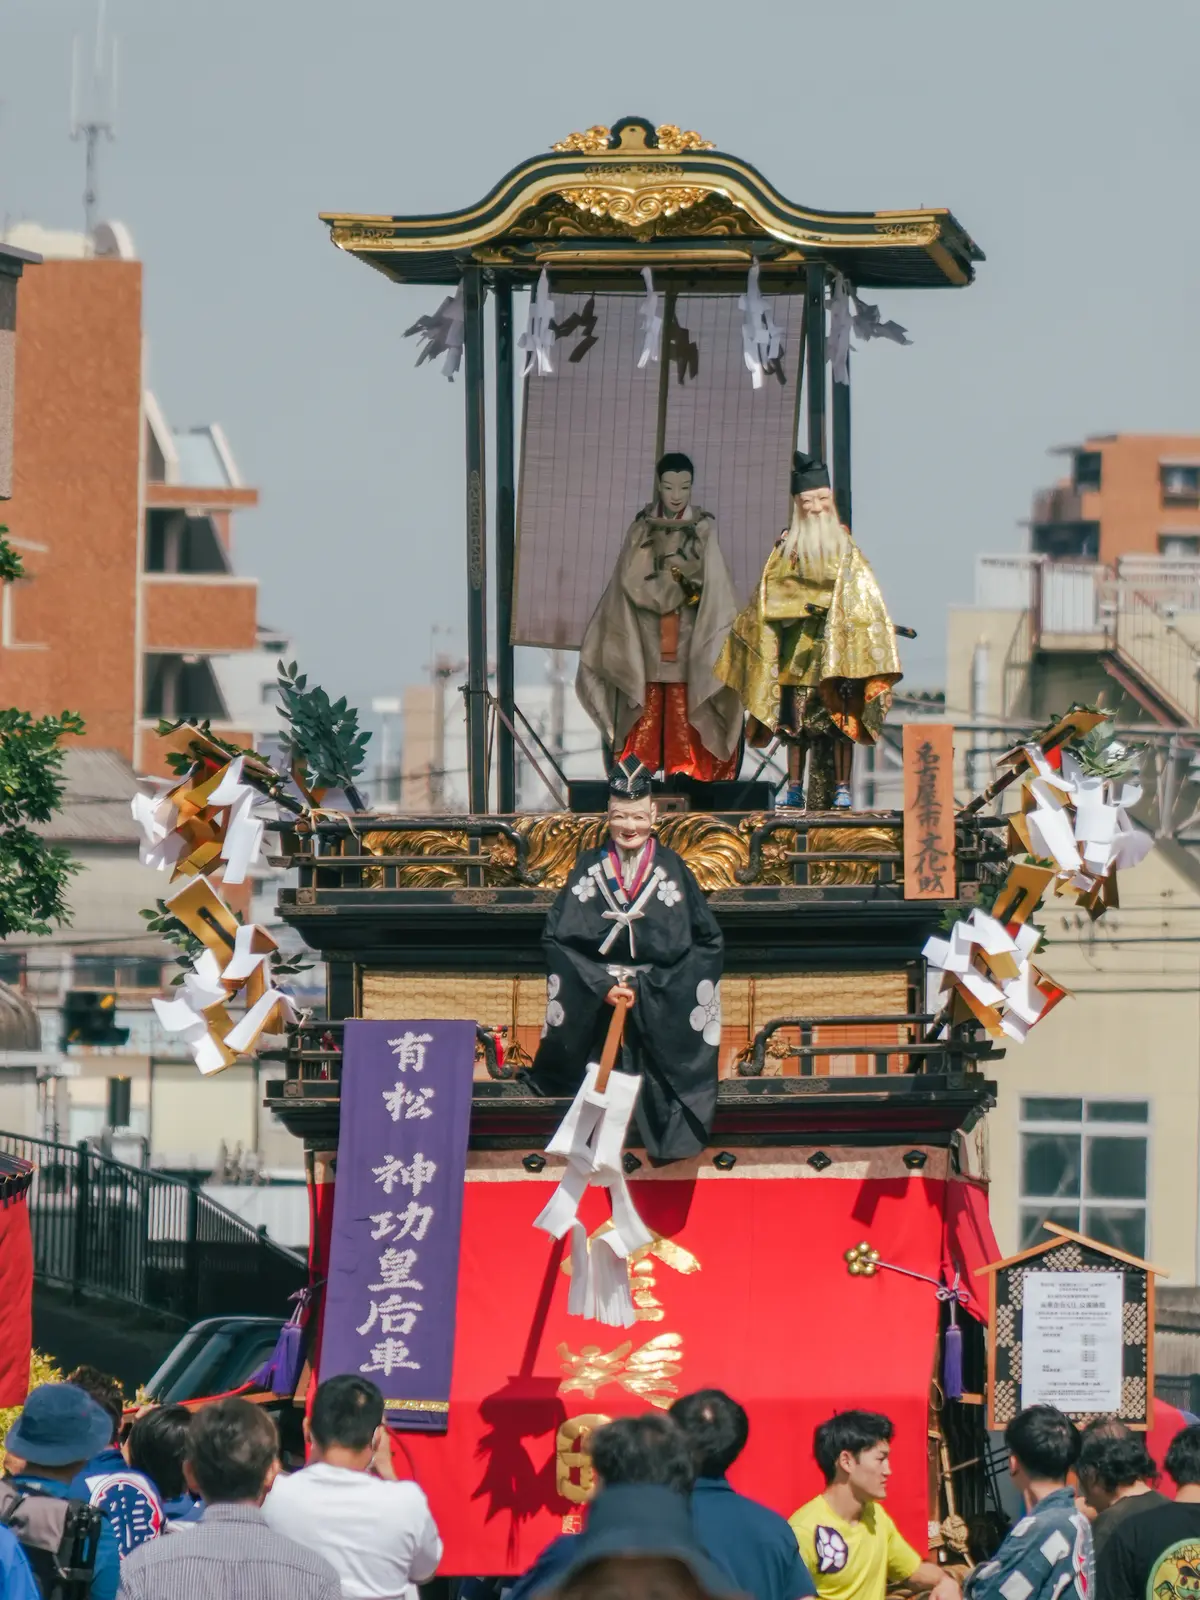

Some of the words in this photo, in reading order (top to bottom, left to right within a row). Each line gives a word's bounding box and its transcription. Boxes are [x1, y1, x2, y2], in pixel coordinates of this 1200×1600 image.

[382, 1031, 434, 1122] 有松
[356, 1152, 437, 1377] 神功皇后車
